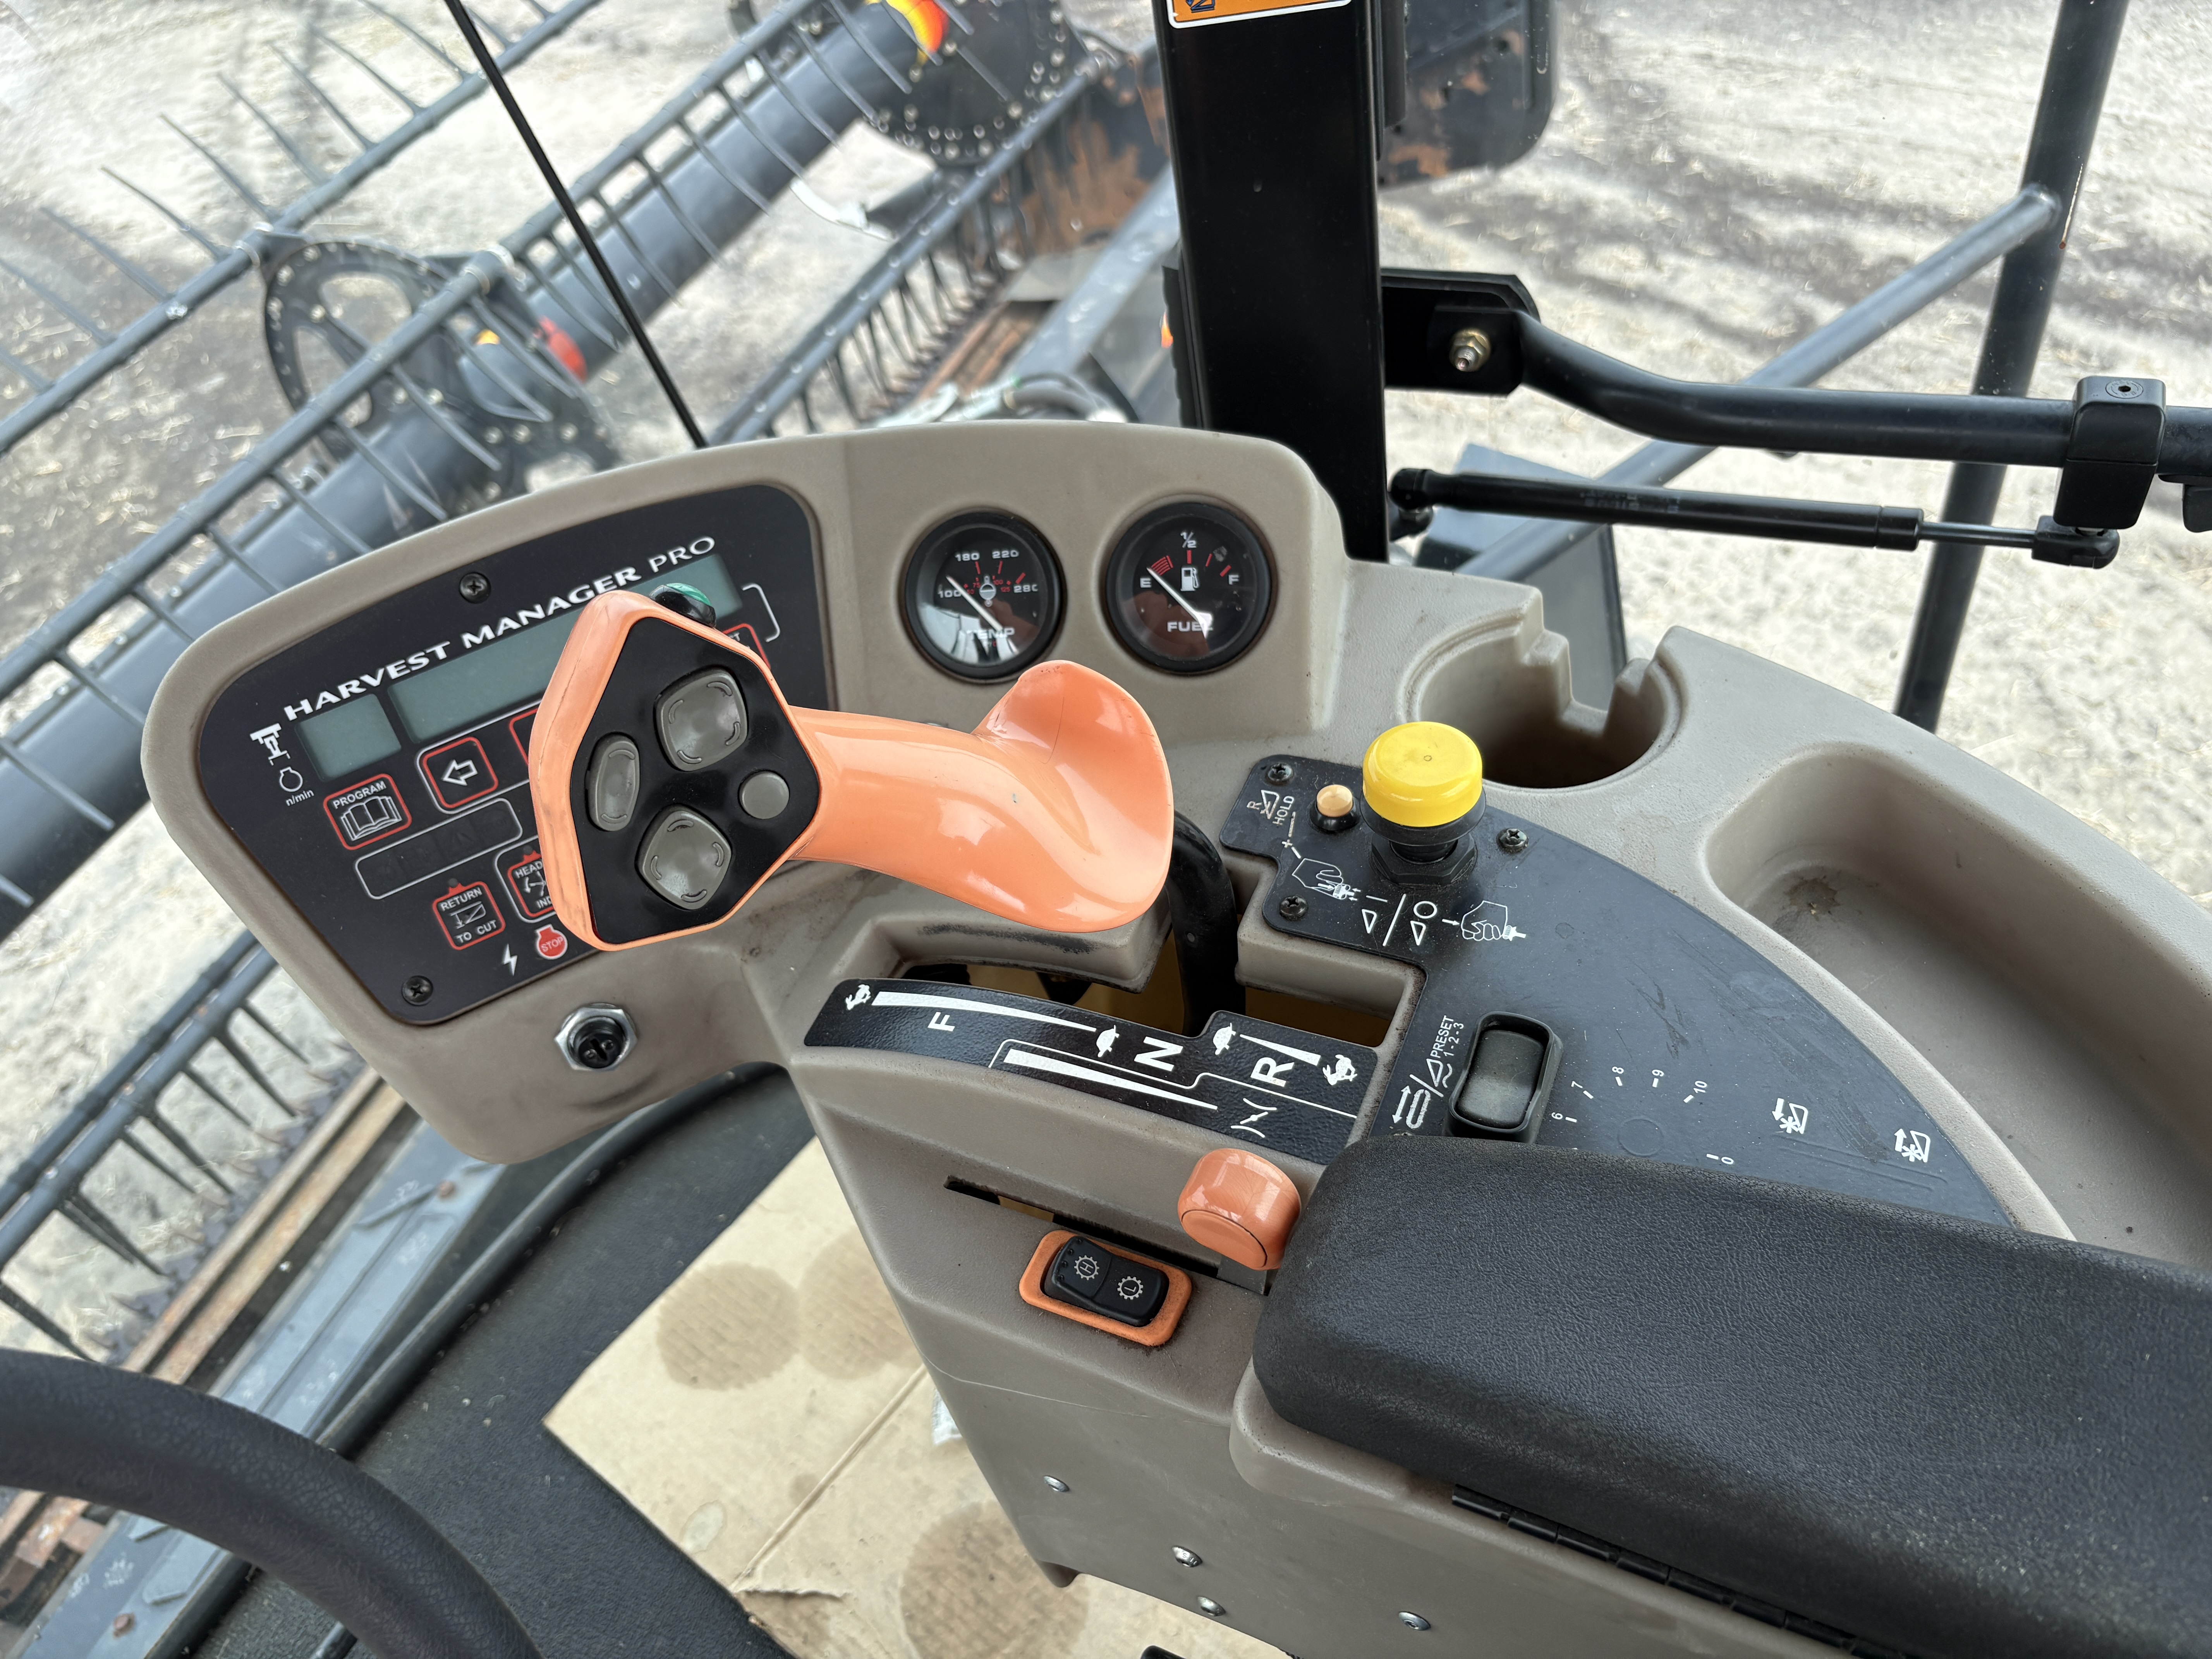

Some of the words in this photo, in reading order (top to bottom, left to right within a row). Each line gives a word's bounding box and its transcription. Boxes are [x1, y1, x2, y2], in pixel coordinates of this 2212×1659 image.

[955, 553, 980, 562] 180
[992, 550, 1019, 559] 220
[1140, 578, 1152, 588] E
[1228, 574, 1239, 585] F
[938, 590, 962, 598] 100
[284, 641, 450, 721] HARVEST
[460, 566, 642, 649] MANAGER
[649, 536, 715, 573] PRO
[285, 789, 314, 807] n/min
[333, 780, 387, 809] PROGRAM
[1247, 800, 1262, 810] R
[1272, 795, 1295, 825] HOLD
[440, 887, 483, 912] RETURN
[456, 931, 472, 944] TO
[476, 919, 497, 935] CUT
[541, 936, 564, 953] STOP
[927, 1012, 955, 1032] F
[1430, 1015, 1454, 1058] PRESET
[1134, 1036, 1183, 1072] N
[1250, 1057, 1295, 1087] R
[1611, 1066, 1624, 1074] 8
[1651, 1069, 1664, 1077] 9
[1571, 1080, 1583, 1089] 7
[1693, 1080, 1707, 1093] 10
[1551, 1112, 1563, 1120] 6
[1721, 1156, 1734, 1165] 0
[1080, 1261, 1094, 1274] H
